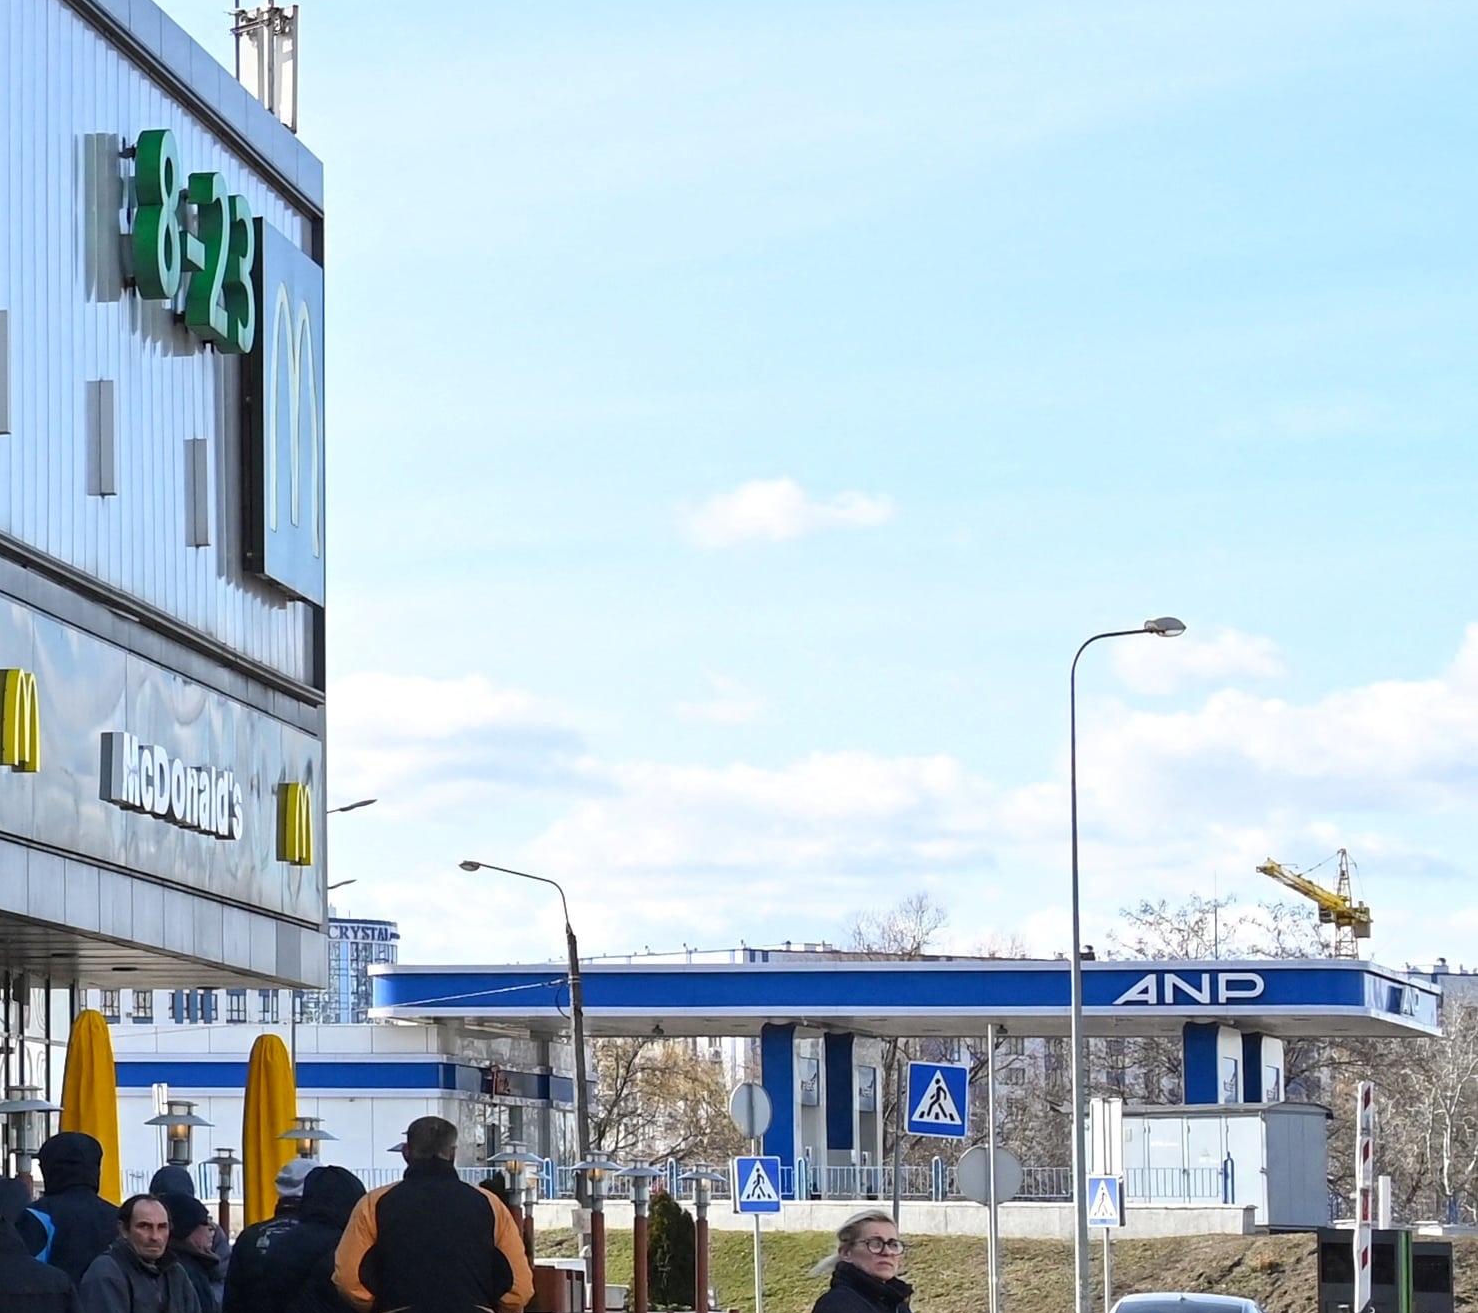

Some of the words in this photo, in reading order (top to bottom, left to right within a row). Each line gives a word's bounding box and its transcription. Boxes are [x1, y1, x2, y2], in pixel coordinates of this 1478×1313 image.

[134, 129, 255, 353] 8-23
[113, 732, 243, 841] McDonald's
[1112, 972, 1265, 1005] ANP
